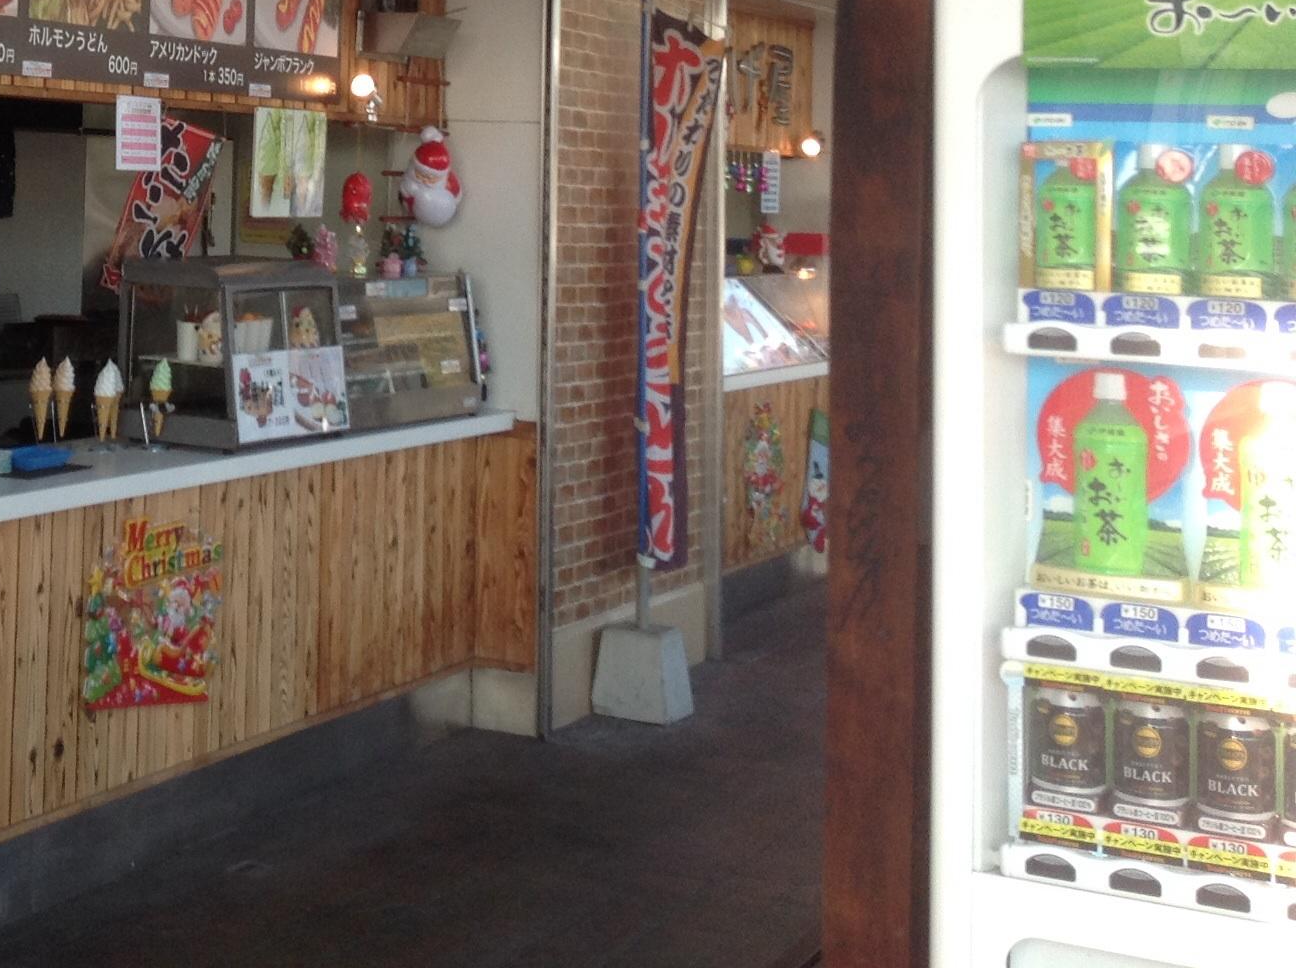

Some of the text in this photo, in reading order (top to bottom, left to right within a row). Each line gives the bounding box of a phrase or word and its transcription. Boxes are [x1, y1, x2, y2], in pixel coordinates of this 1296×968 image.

[28, 25, 108, 54] ホルモンうどん
[107, 55, 138, 76] 600円
[254, 52, 316, 75] ジャンボフランク
[217, 68, 245, 87] 350円
[1086, 476, 1128, 547] お茶
[1040, 753, 1090, 772] BLACK
[1122, 765, 1173, 784] BLACK
[1208, 779, 1260, 798] BLACK
